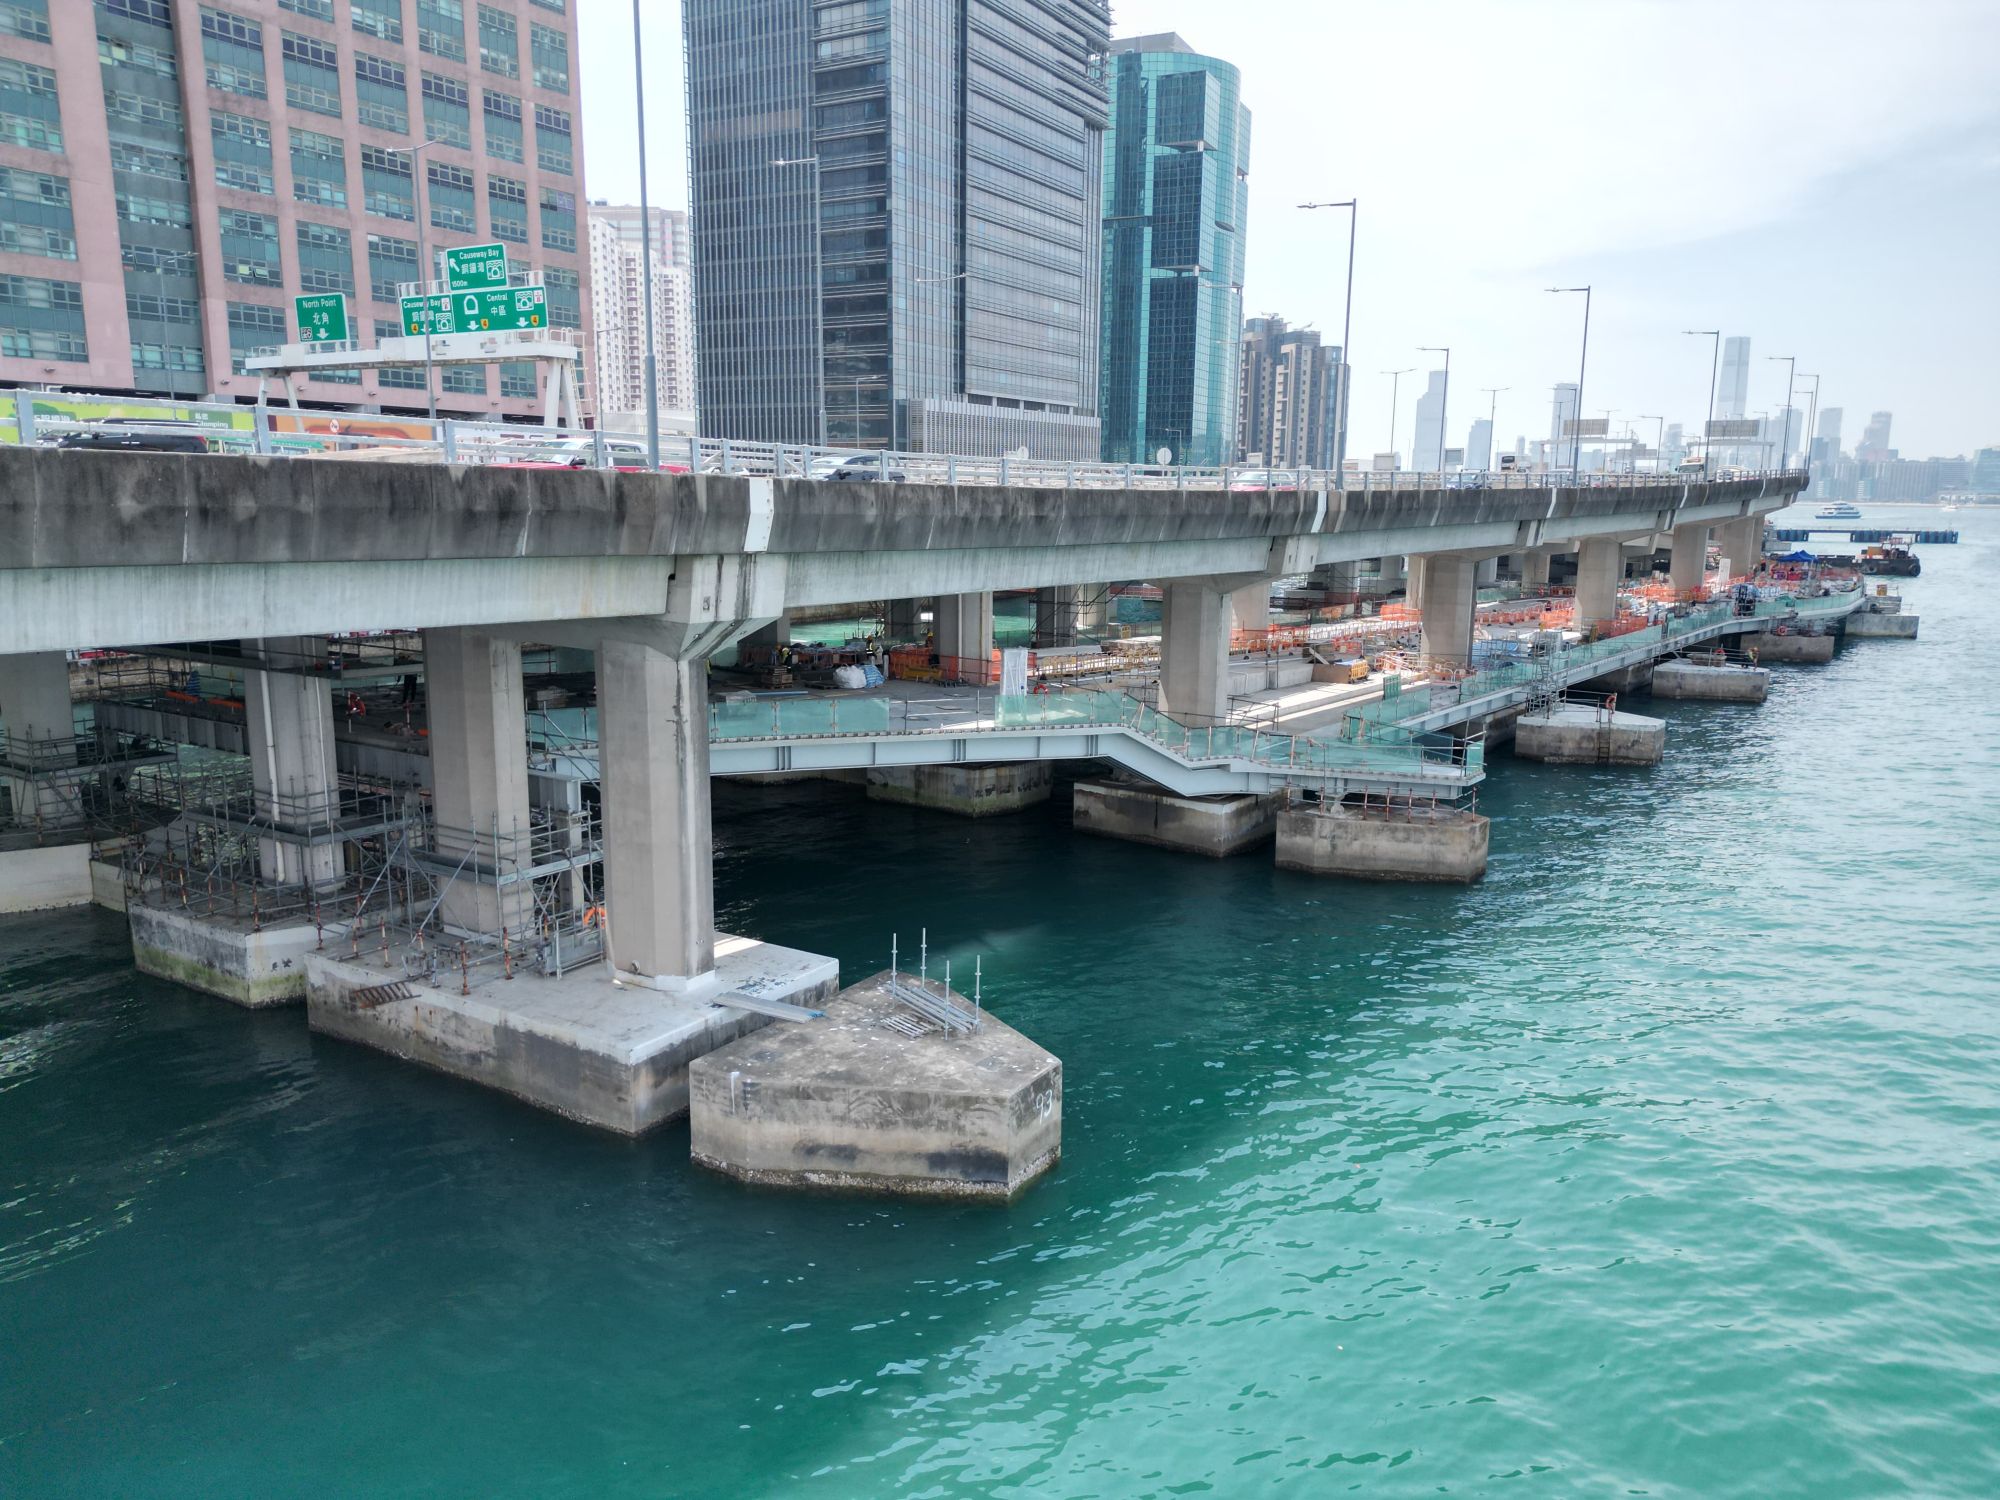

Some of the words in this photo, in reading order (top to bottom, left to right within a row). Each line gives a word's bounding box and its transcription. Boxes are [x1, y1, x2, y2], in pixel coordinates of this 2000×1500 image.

[459, 251, 487, 259] Causeway
[487, 249, 499, 257] Bay
[486, 293, 508, 302] Central
[303, 300, 320, 308] North
[320, 299, 336, 307] Point
[430, 299, 441, 307] Bay
[491, 304, 506, 316] 中區
[312, 312, 329, 325] 北角
